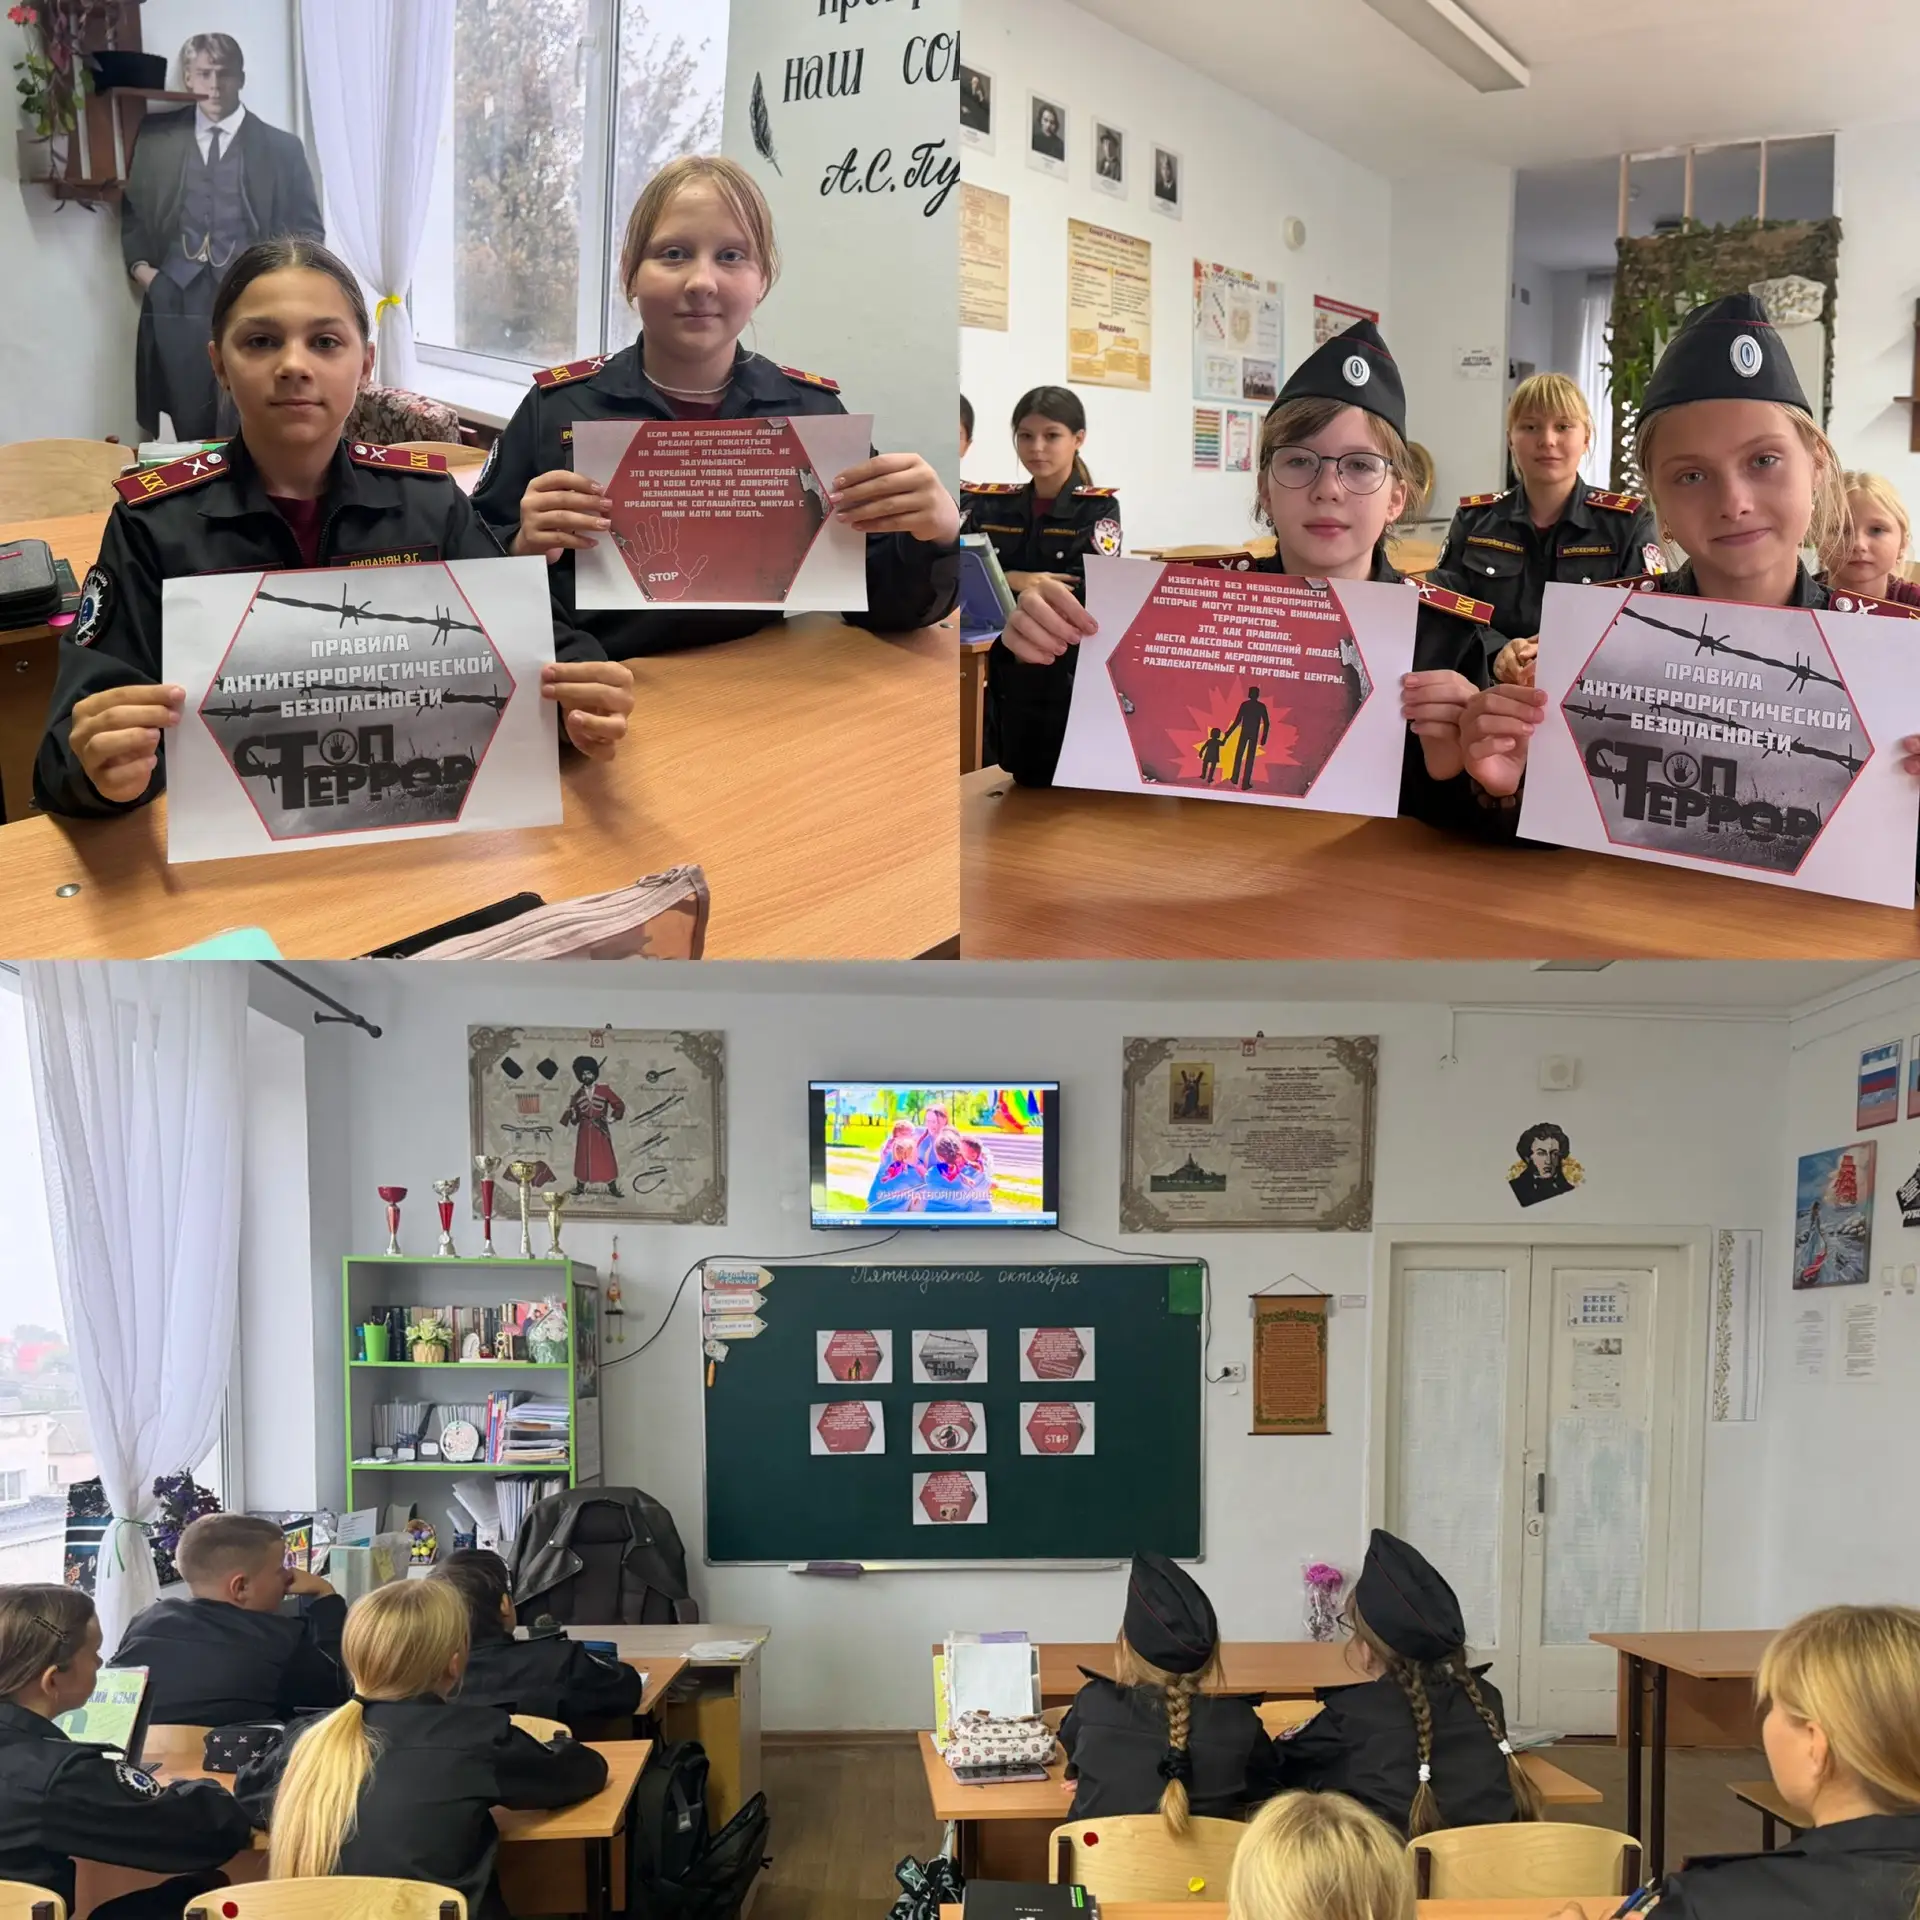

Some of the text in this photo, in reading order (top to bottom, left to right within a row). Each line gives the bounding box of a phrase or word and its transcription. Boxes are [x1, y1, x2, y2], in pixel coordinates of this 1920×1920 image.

[783, 29, 960, 103] наш со
[672, 430, 690, 438] ВАМ
[694, 429, 752, 438] НЕЗНАКОМЫЕ
[657, 438, 771, 448] ПРЕДЛАГАЮТ ПОКАТАТЬСЯ
[638, 450, 649, 458] НА
[653, 449, 690, 457] МАШИНЕ
[630, 469, 645, 478] ЭТО
[648, 469, 697, 478] ОЧЕРЕДНАЯ
[700, 469, 733, 478] УЛОВКА
[638, 477, 789, 488] НИ В КОЕМ СЛУЧАЕ НЕ ДОВЕРЯЙТЕ
[642, 489, 785, 499] НЕЗНАКОМЦАМ И НЕ ПОД КАКИМ
[624, 500, 673, 508] ПРЕДЛОГОМ
[677, 500, 688, 508] НЕ
[691, 498, 757, 508] СОГЛАШАЙТЕСЬ
[760, 500, 795, 508] НИКУДА
[662, 510, 685, 518] НИМИ
[689, 510, 711, 519] ИДТИ
[715, 510, 732, 518] ИЛИ
[648, 572, 680, 582] STOP
[1160, 585, 1218, 599] ПОСЕЩЕНИЯ
[1223, 591, 1247, 601] МЕСТ
[1252, 594, 1258, 602] И
[1168, 575, 1327, 598] ИЗБЕГАЙТЕ БЕЗ НЕОБХОДИМОСТИ
[1153, 596, 1342, 622] КОТОРЫЕ МОГУТ ПРИВЛЕЧЬ ВНИМАНИЕ
[1212, 613, 1280, 628] ТЕРРОРИСТОВ.
[1197, 624, 1293, 641] ЭТО, КАК ПРАВИЛО:
[310, 633, 411, 658] ПРАВИЛА
[1144, 644, 1220, 660] МНОГОЛЮДНЫЕ
[1155, 632, 1186, 644] МЕСТА
[1190, 636, 1243, 650] МАССОВЫХ
[1247, 640, 1302, 655] СКОПЛЕНИЙ
[221, 650, 495, 695] АНТИТЕРРОРИСТИЧЕСКОЙ
[1143, 656, 1235, 673] РАЗВЛЕКАТЕЛЬНЫЕ
[1239, 666, 1245, 675] И
[1250, 667, 1300, 681] ТОРГОВЫЕ
[1664, 661, 1764, 691] ПРАВИЛА
[281, 687, 443, 718] БЕЗОПАСНОСТИ
[1581, 678, 1852, 731] АНТИТЕРРОРИСТИЧЕСКОЙ
[1630, 712, 1792, 752] БЕЗОПАСНОСТИ
[851, 1264, 1080, 1294] Пятнадцатое октября
